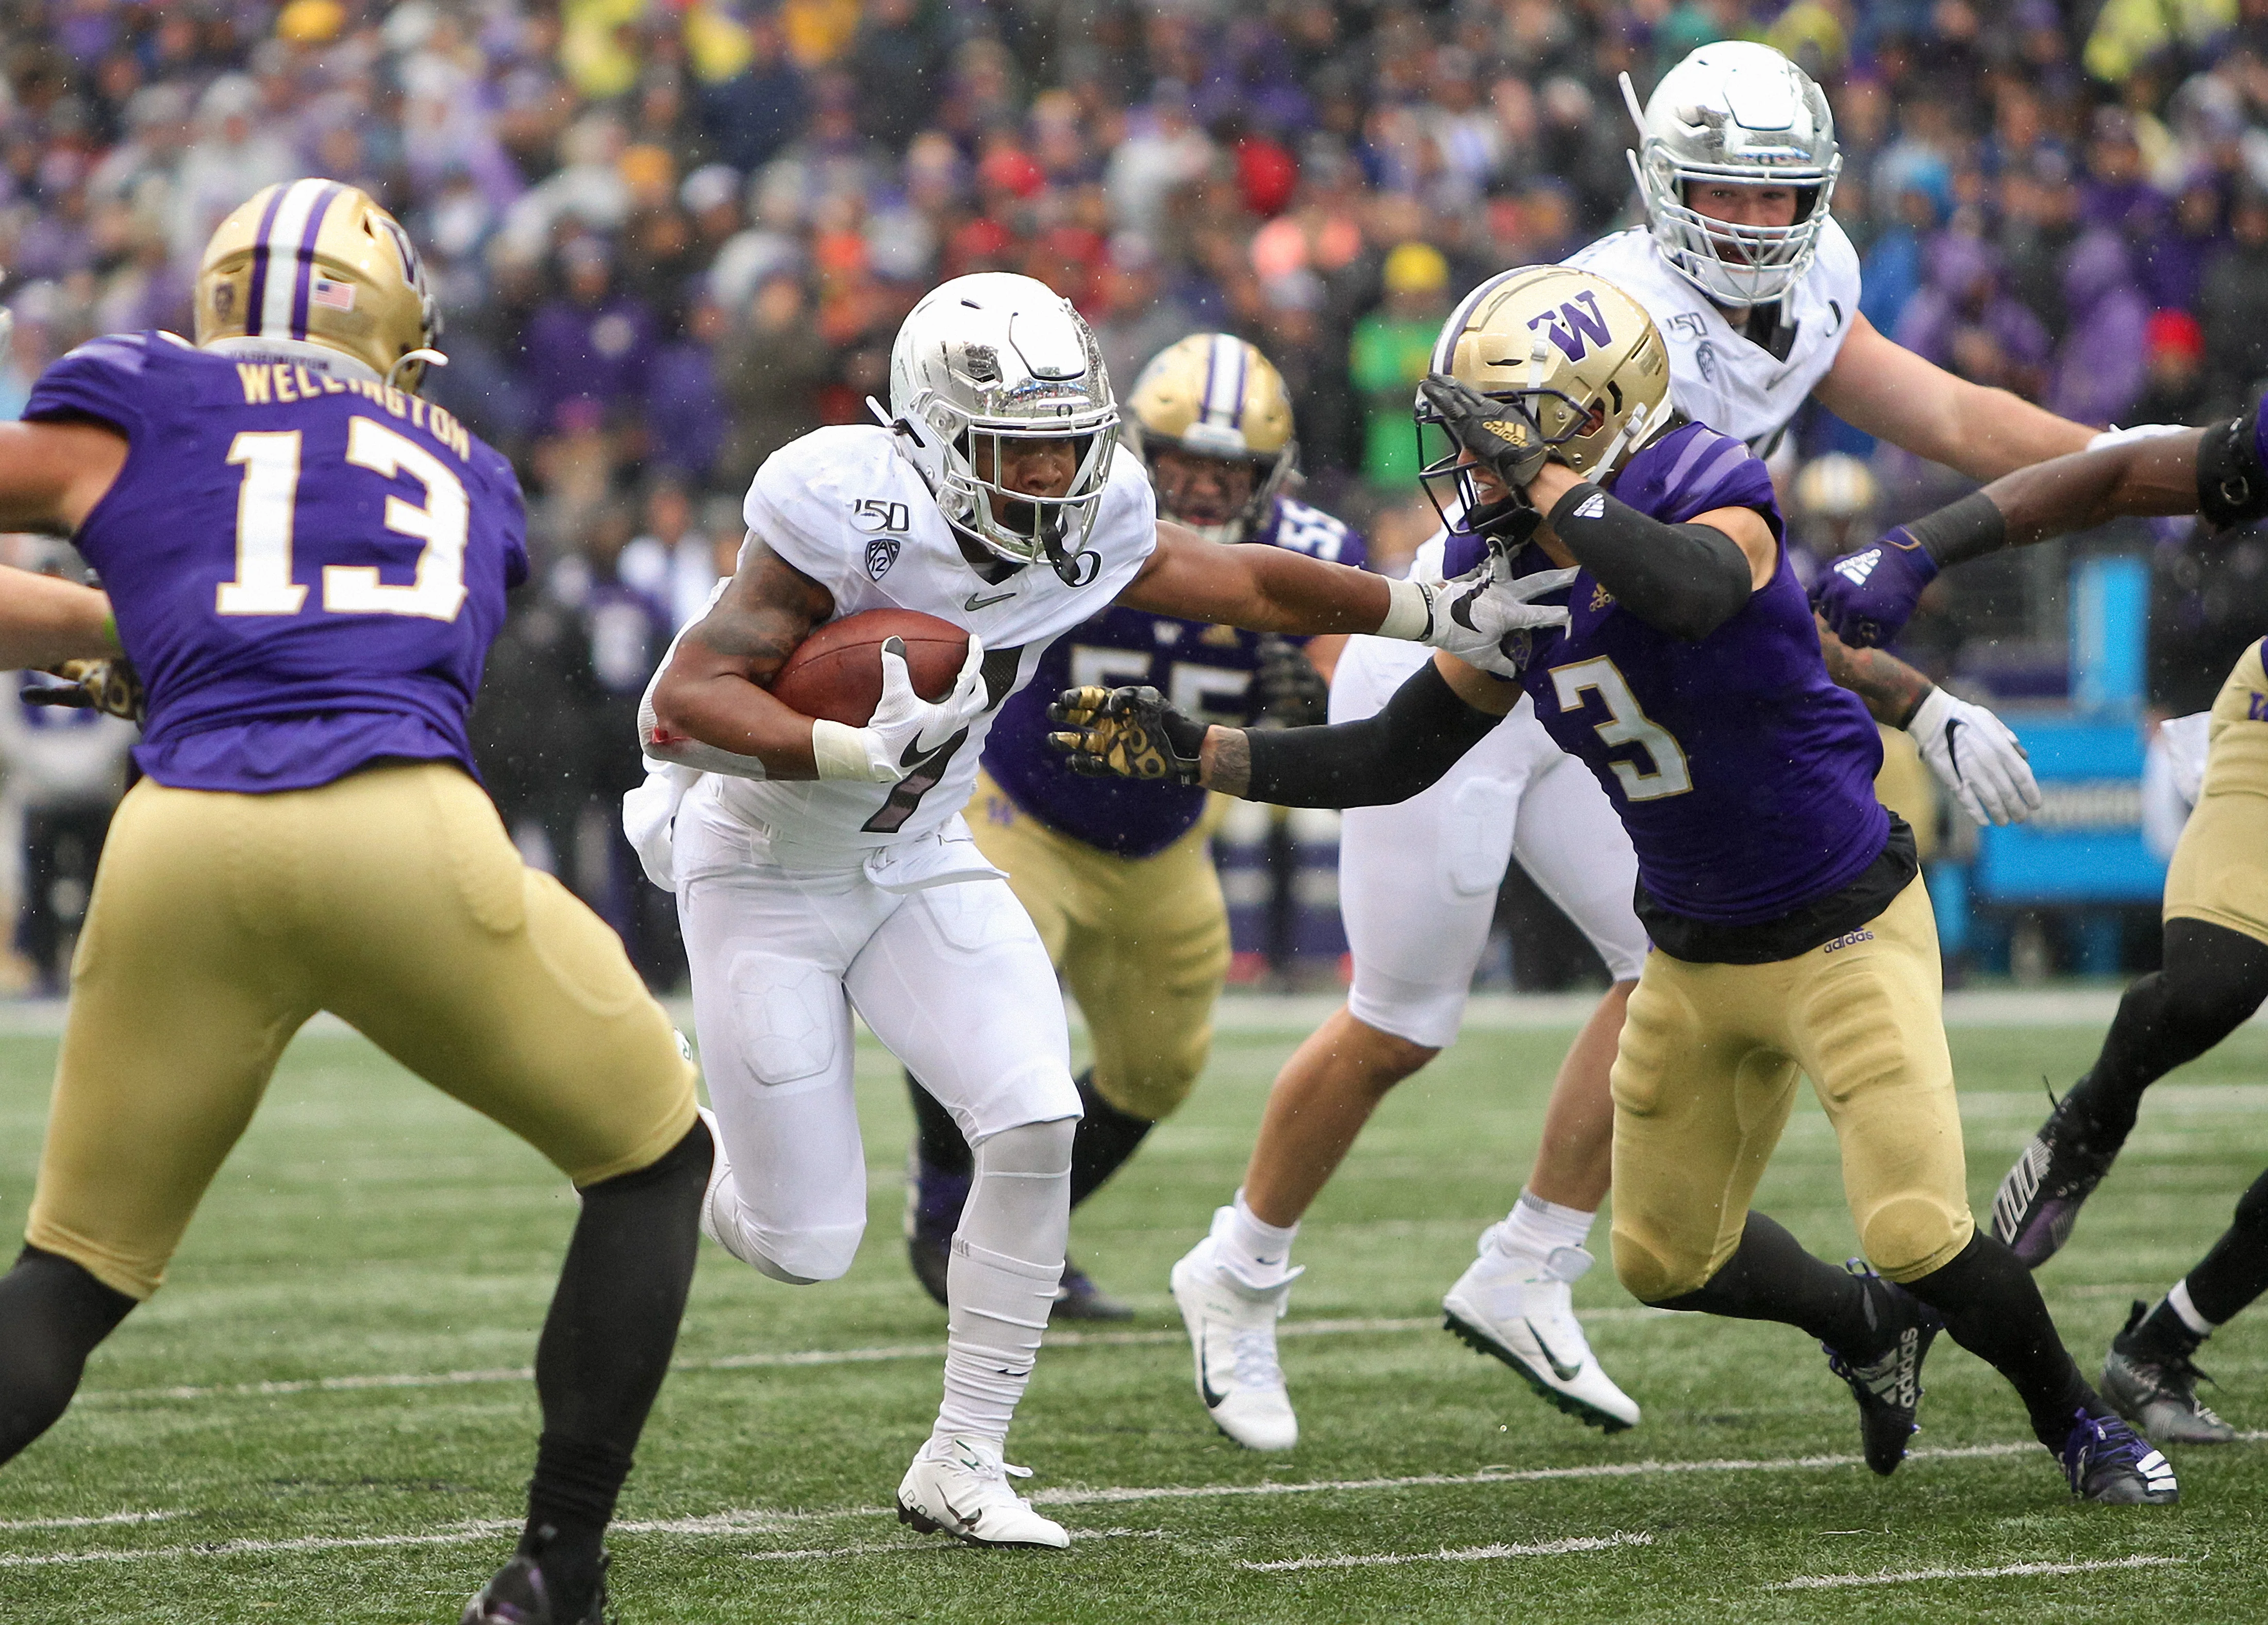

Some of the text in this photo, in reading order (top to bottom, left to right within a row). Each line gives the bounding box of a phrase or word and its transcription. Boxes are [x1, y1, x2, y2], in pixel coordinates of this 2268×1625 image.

[1527, 289, 1613, 364] W
[1666, 312, 1708, 337] 150
[1482, 420, 1530, 449] adidas
[215, 414, 470, 623] 13
[855, 499, 909, 532] 150
[871, 557, 888, 572] 12
[1548, 654, 1694, 802] 3
[1824, 930, 1875, 954] adidas
[1895, 1326, 1919, 1408] adidas
